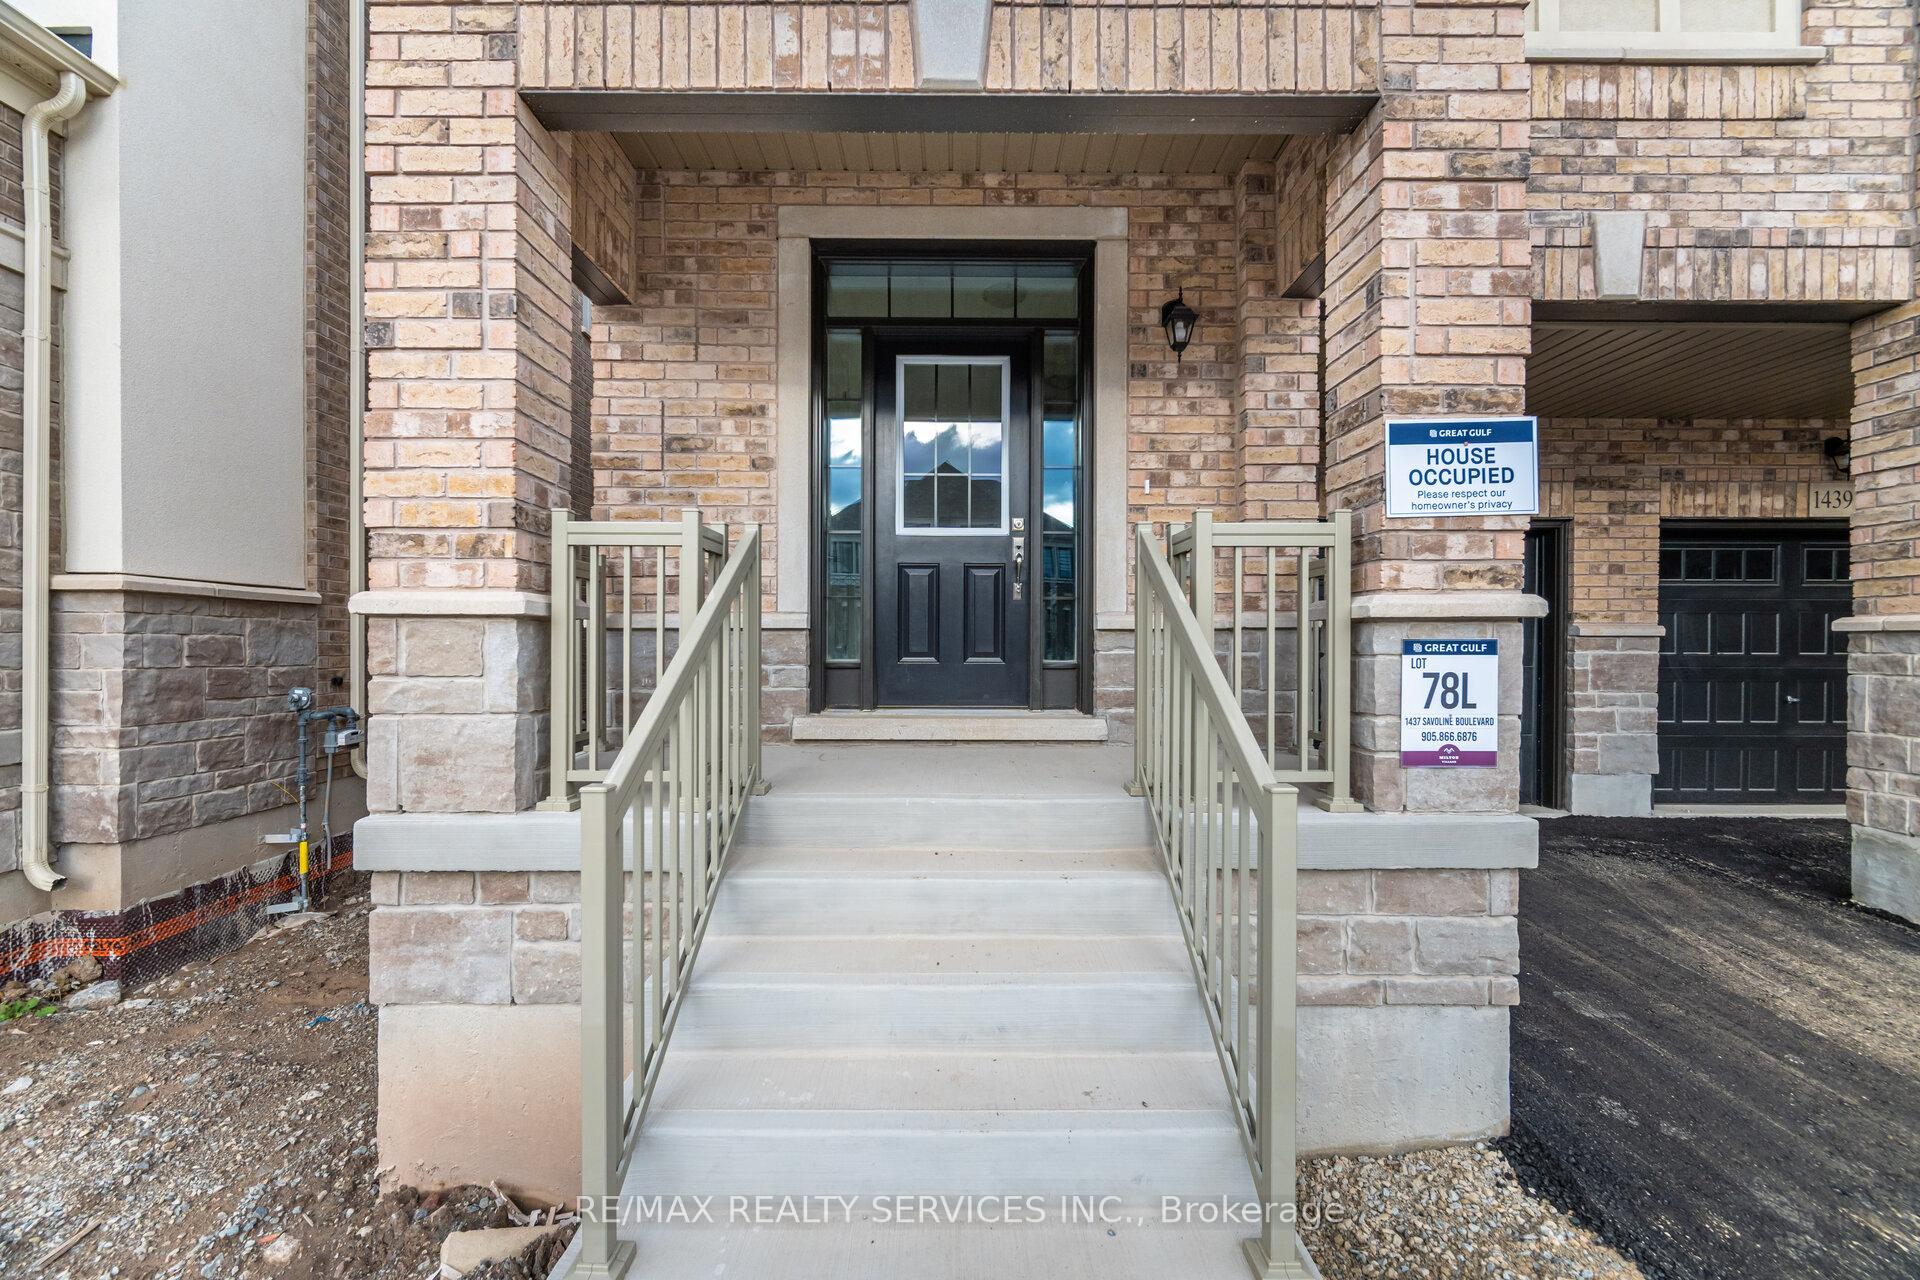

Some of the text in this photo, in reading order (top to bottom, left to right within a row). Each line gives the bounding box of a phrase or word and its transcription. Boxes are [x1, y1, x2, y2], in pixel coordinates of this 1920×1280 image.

[1439, 428, 1492, 437] GREAT GULF
[1426, 447, 1496, 465] HOUSE
[1408, 467, 1515, 486] OCCUPIED
[1417, 489, 1506, 500] Please respect our
[1813, 489, 1853, 510] 1439
[1411, 500, 1513, 510] homeowner's privacy
[1424, 643, 1488, 652] GREAT GULF
[1411, 657, 1427, 669] LOT
[1422, 671, 1477, 710] 78L
[1405, 717, 1495, 726] 1437 SAVOLINE BOULEVARD
[1421, 731, 1478, 742] 905.866.6876
